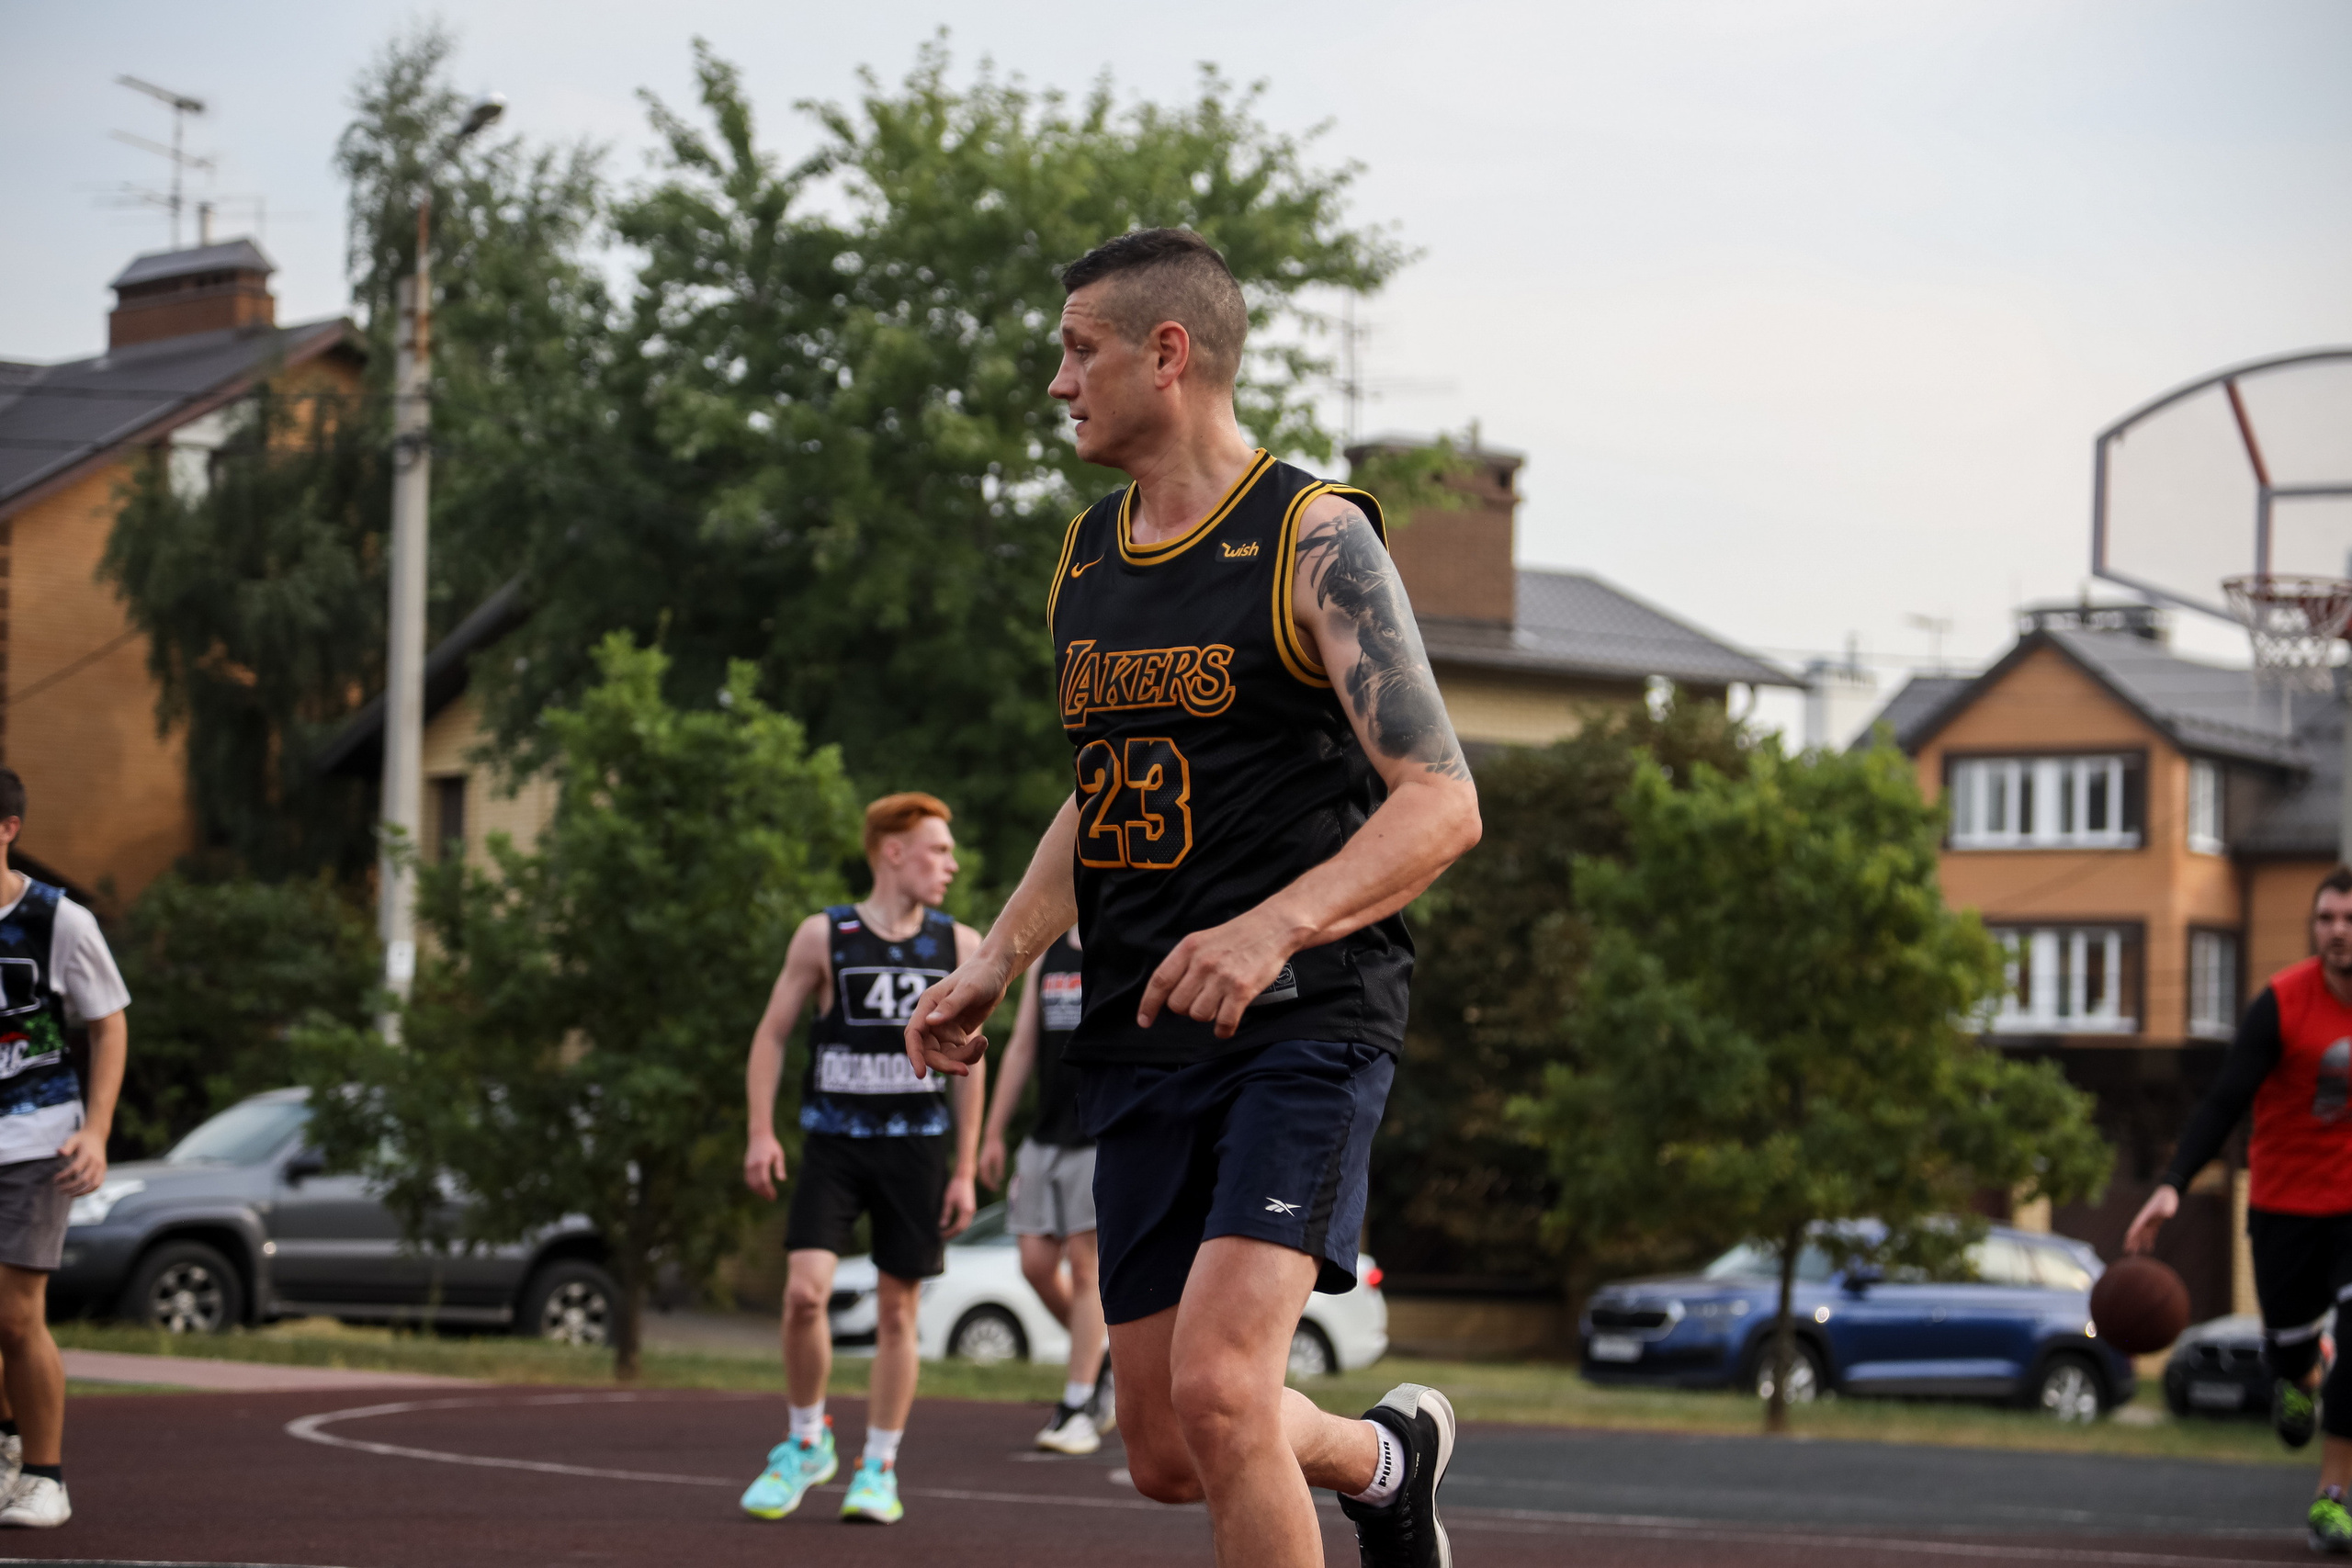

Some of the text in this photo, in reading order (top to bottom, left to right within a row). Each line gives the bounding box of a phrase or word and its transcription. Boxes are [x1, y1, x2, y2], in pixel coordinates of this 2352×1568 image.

[1059, 639, 1236, 728] LAKERS
[1077, 738, 1193, 869] 23
[864, 972, 927, 1019] 42
